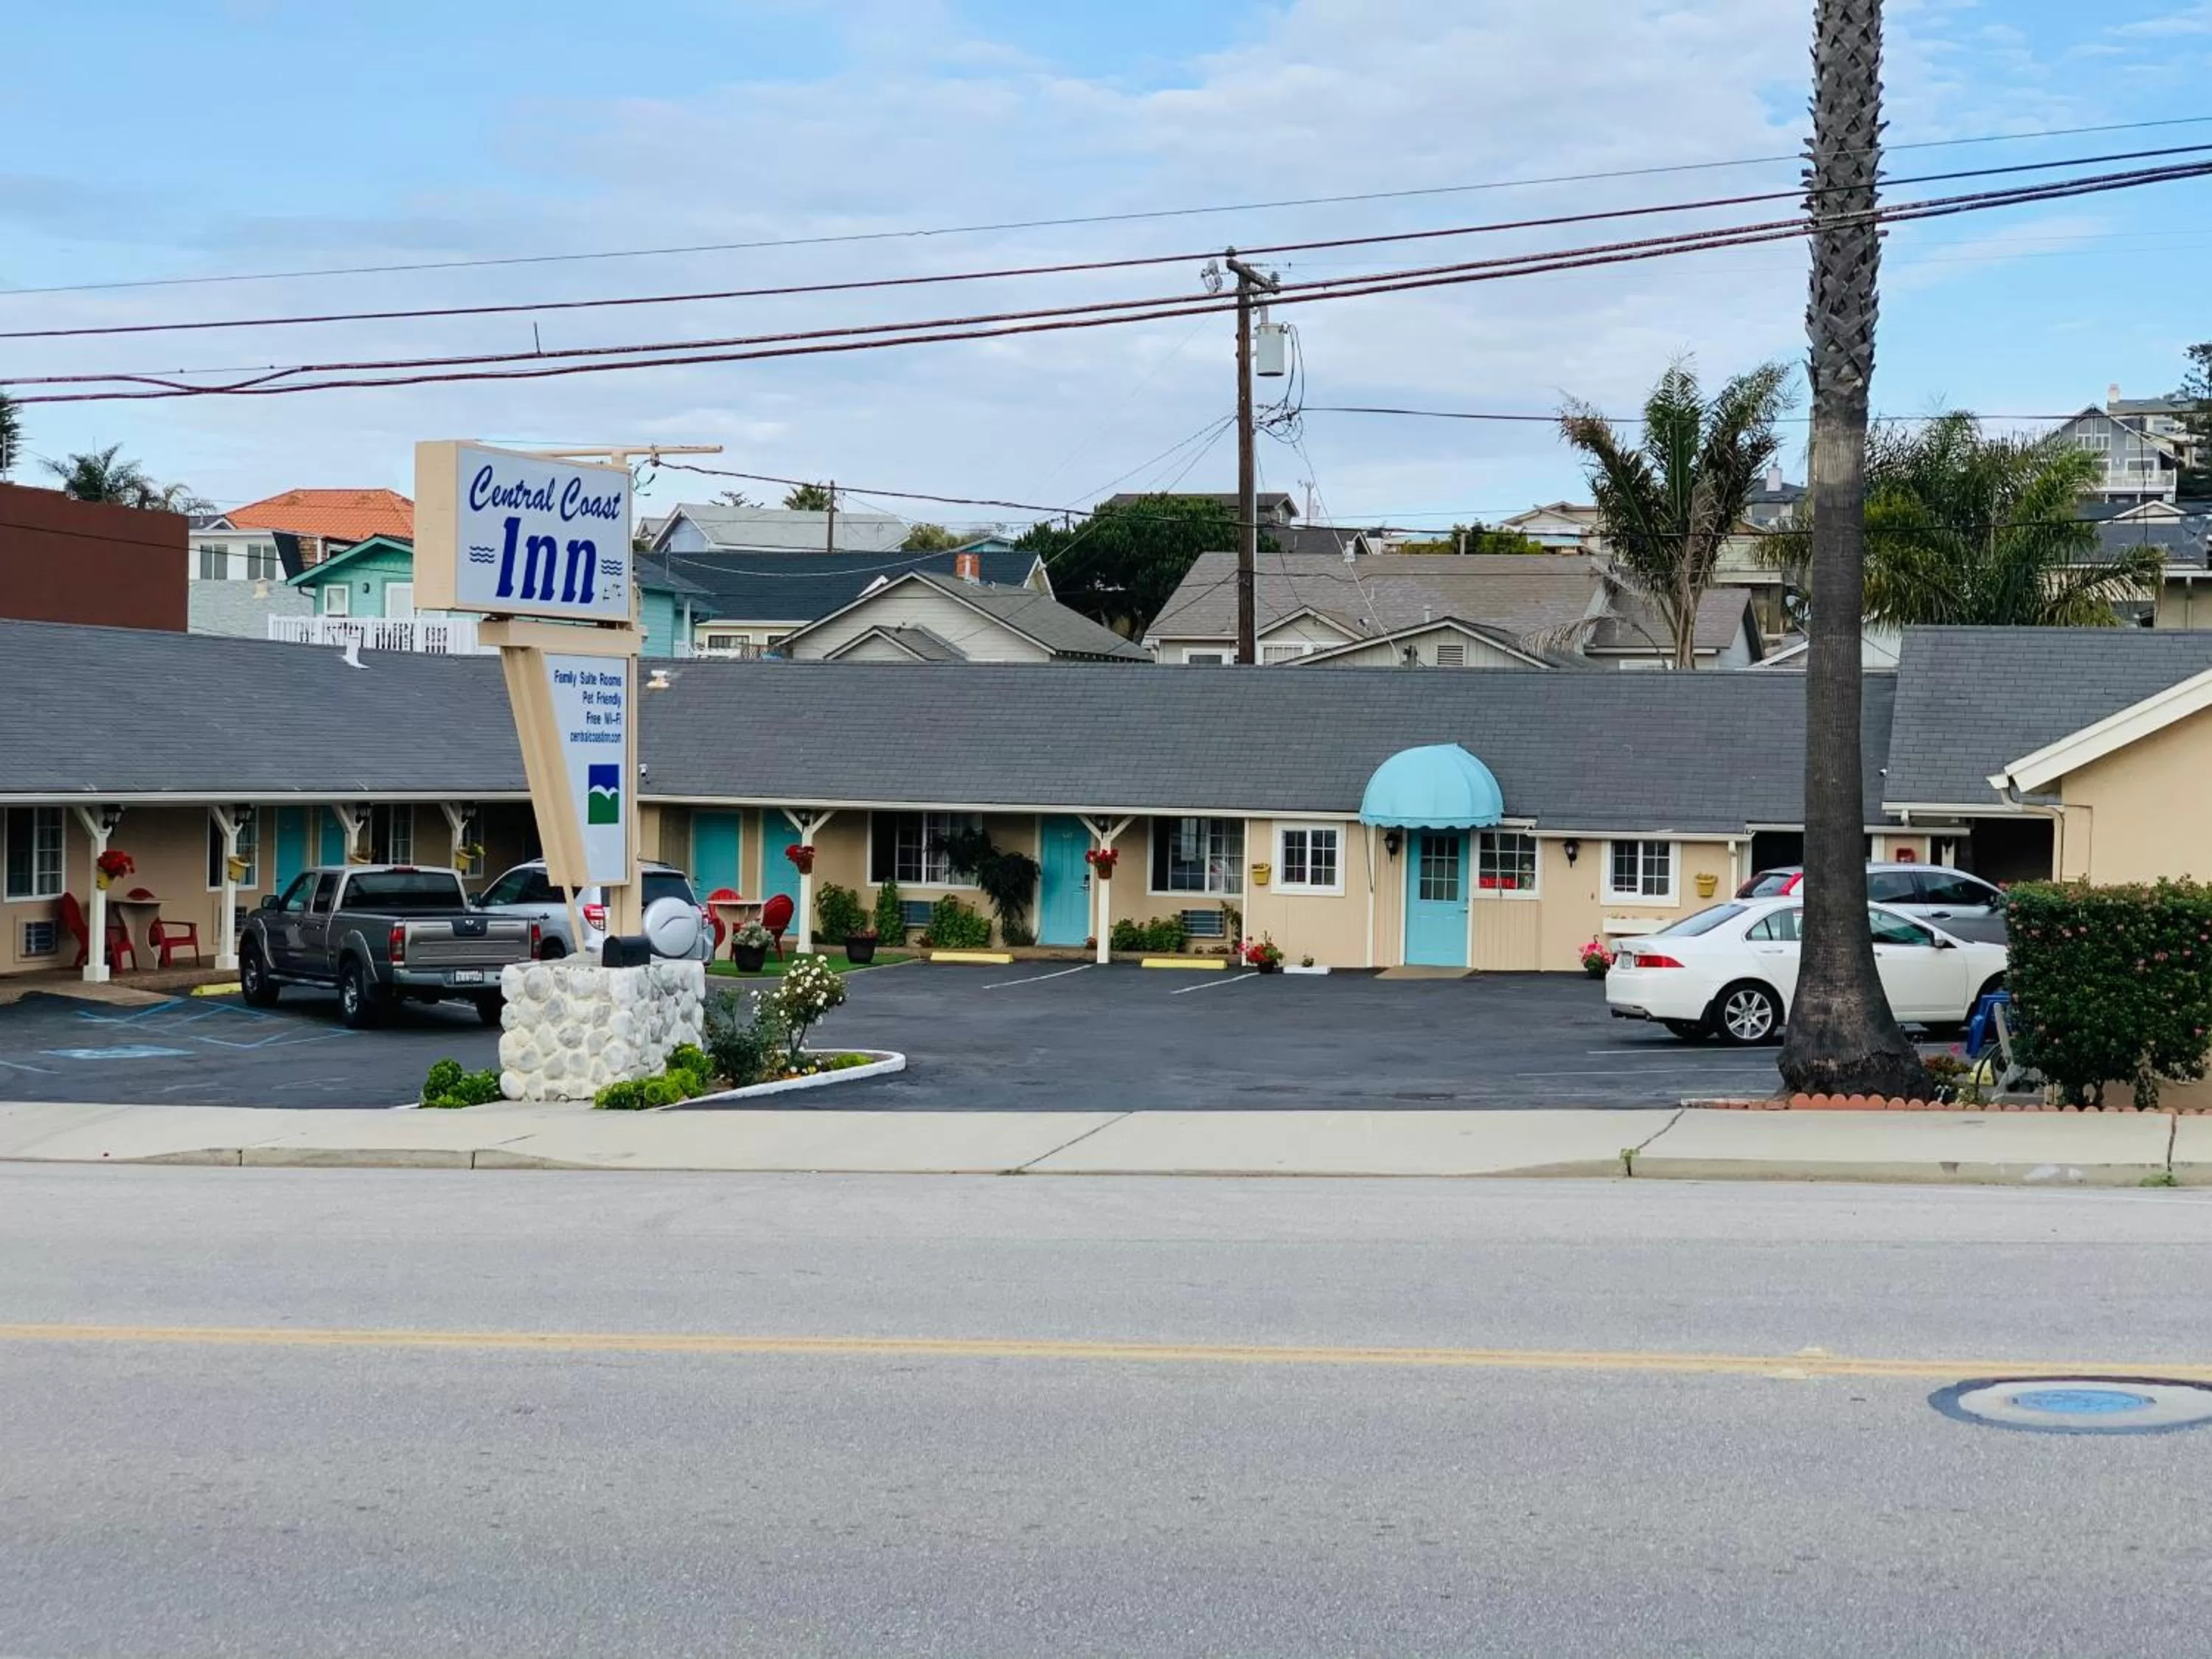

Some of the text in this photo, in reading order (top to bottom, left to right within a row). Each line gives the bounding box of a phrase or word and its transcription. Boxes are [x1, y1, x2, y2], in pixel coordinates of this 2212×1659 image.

[470, 465, 622, 522] Central Coast
[495, 516, 597, 604] Inn
[554, 669, 622, 687] Family Suite Rooms
[582, 691, 622, 708] Pet Friendly
[586, 712, 601, 724] Free
